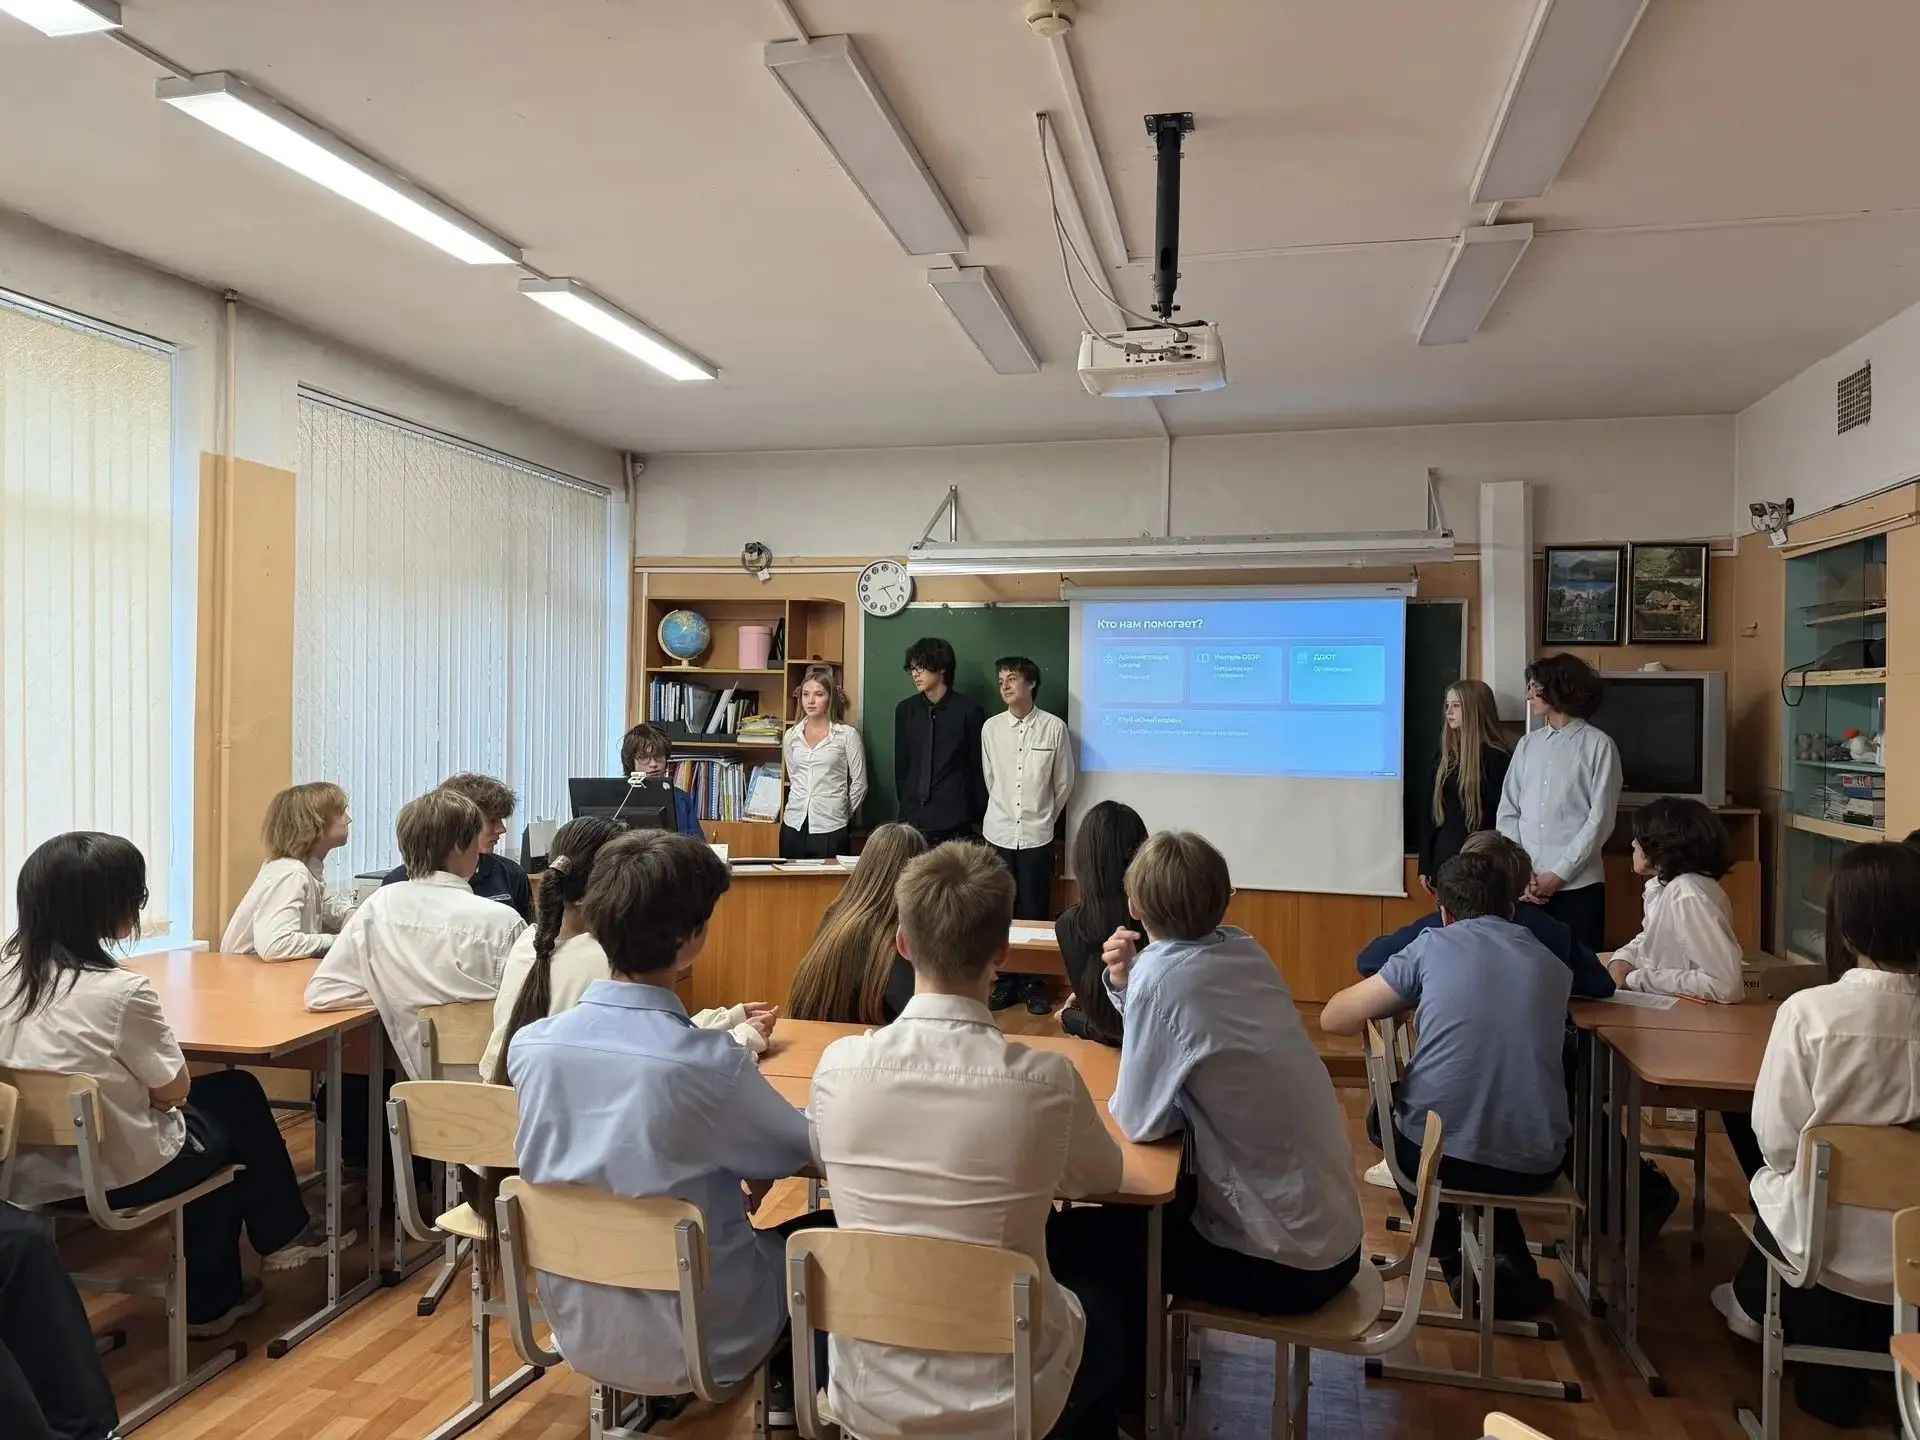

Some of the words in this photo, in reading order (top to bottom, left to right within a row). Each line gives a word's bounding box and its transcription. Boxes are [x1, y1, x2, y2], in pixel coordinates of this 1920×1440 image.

[1097, 619, 1118, 629] Кто
[1119, 621, 1141, 629] нам
[1143, 618, 1203, 629] помогает?
